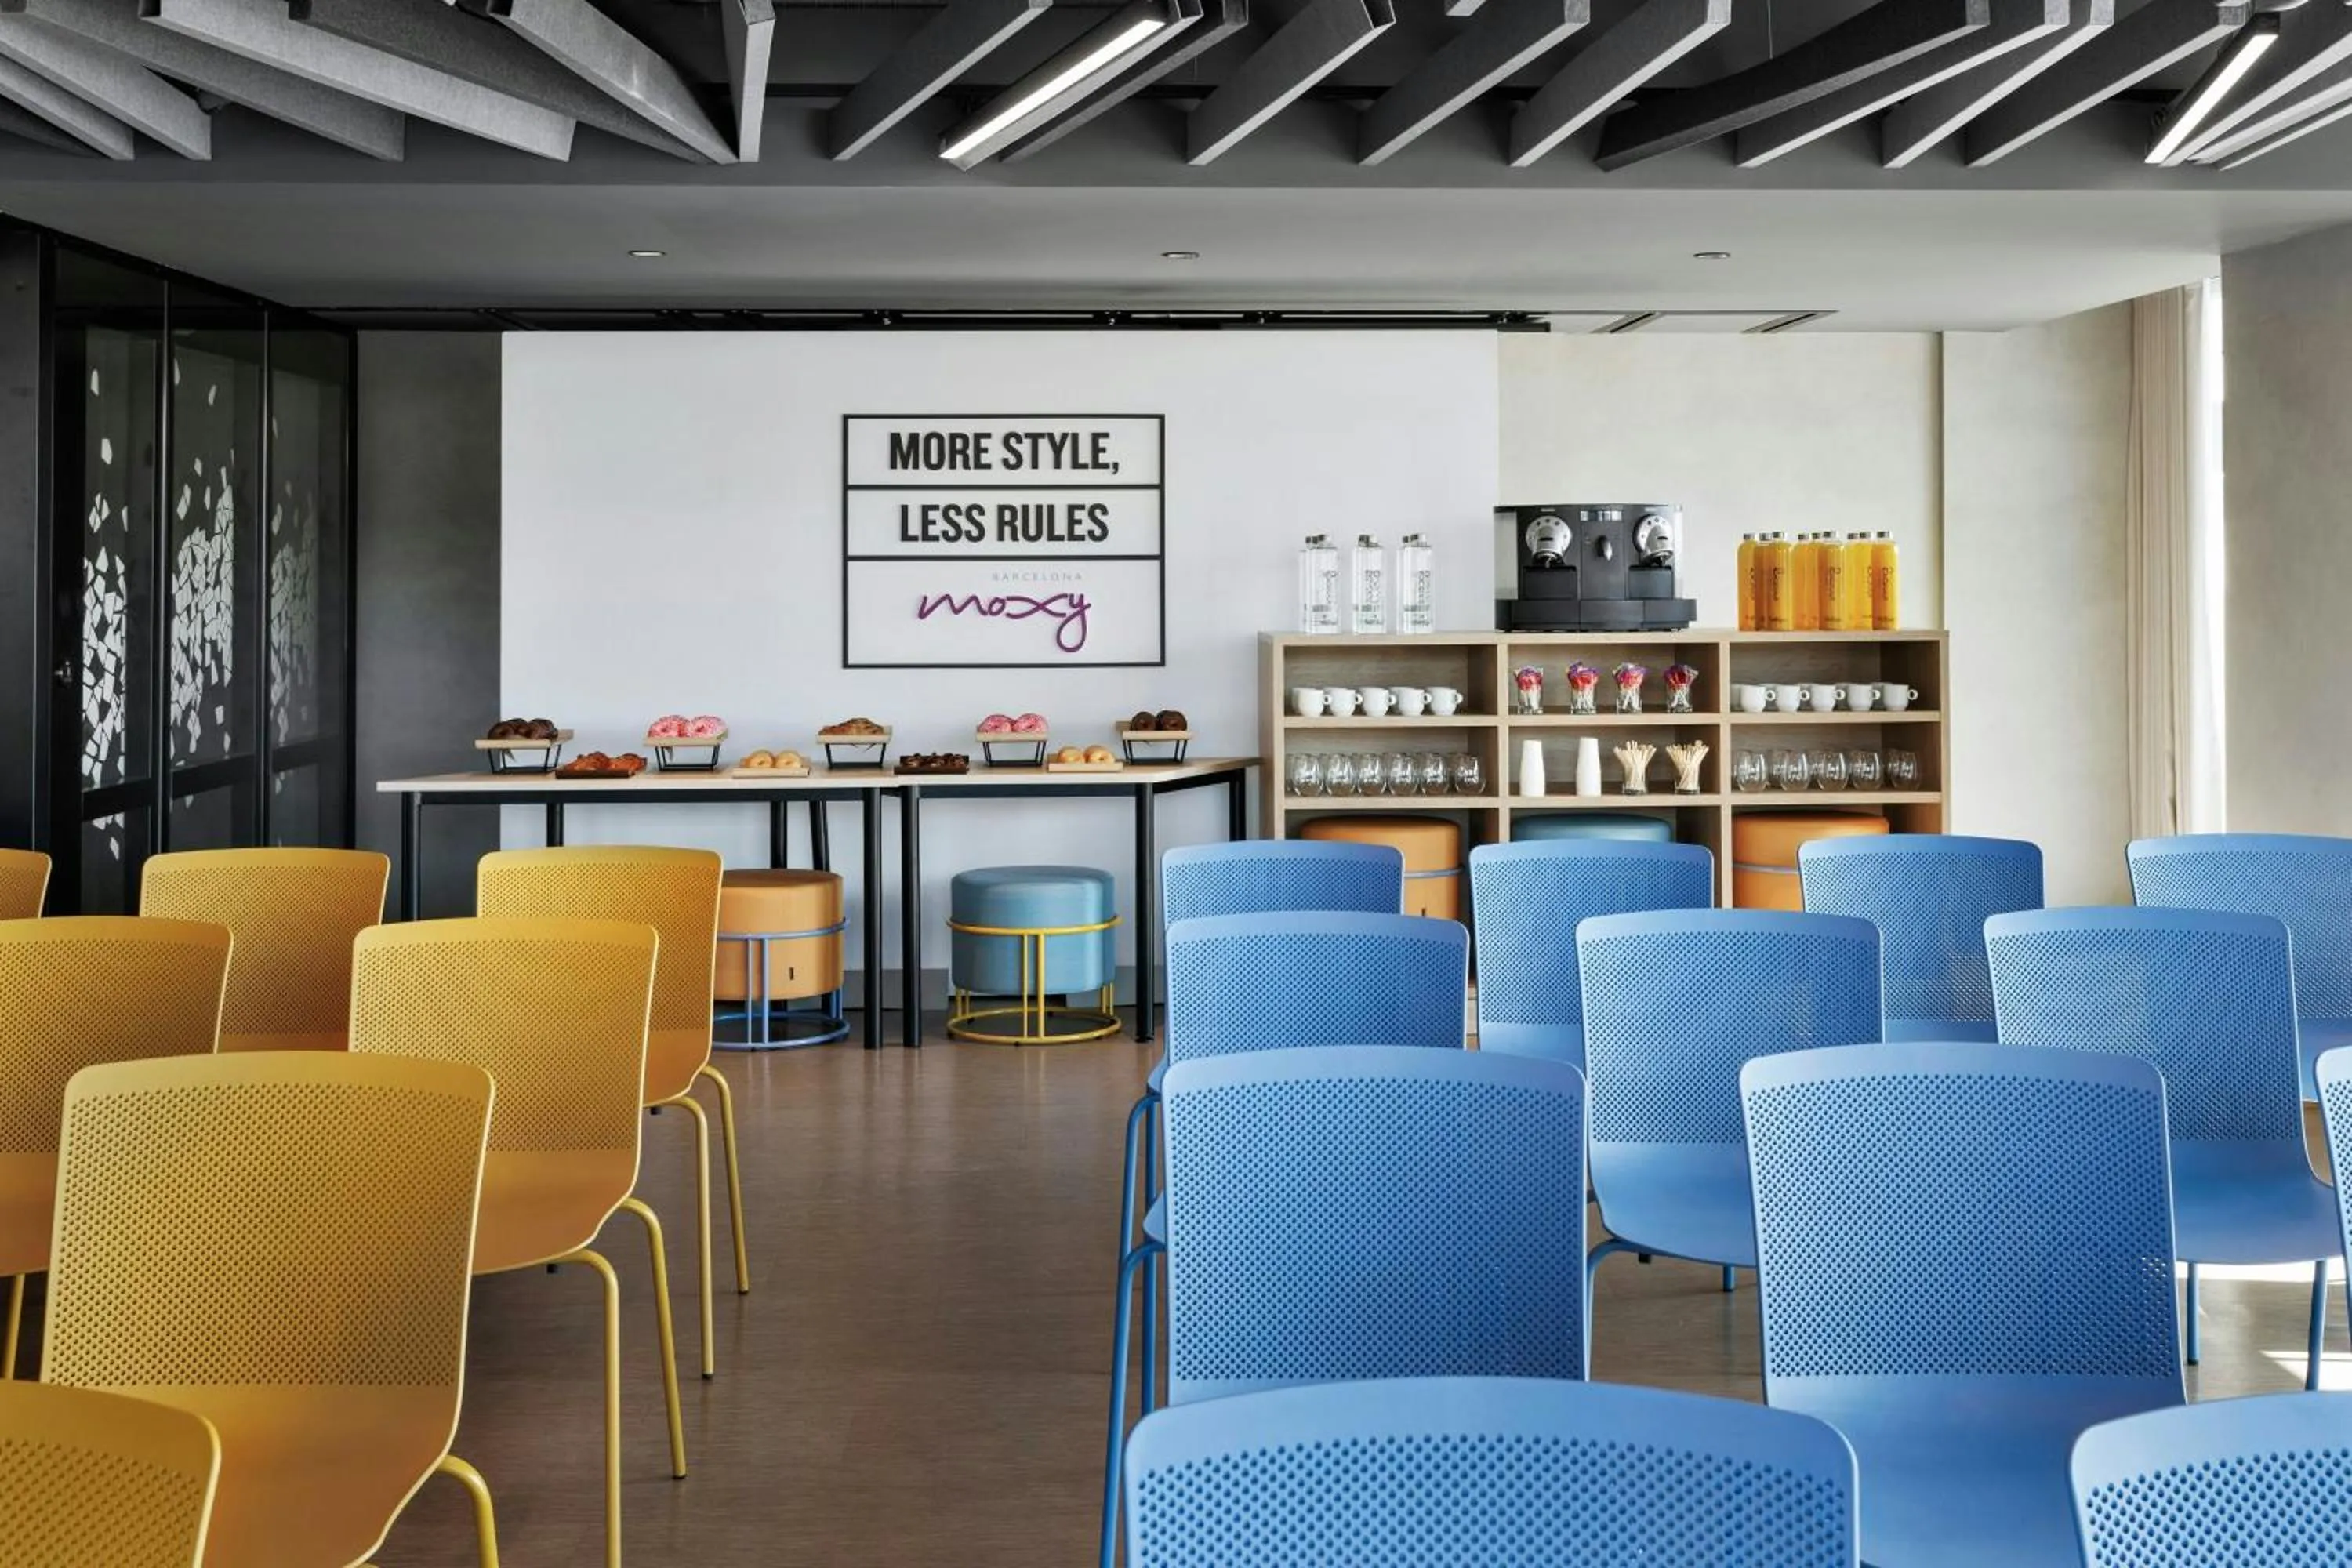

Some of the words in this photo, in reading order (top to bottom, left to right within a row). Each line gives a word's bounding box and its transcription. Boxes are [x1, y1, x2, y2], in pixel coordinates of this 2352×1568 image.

[890, 430, 992, 470] MORE
[1001, 430, 1120, 475] STYLE,
[900, 503, 985, 543] LESS
[996, 503, 1109, 543] RULES
[992, 572, 1083, 581] BARCELONA
[916, 592, 1092, 653] moxy
